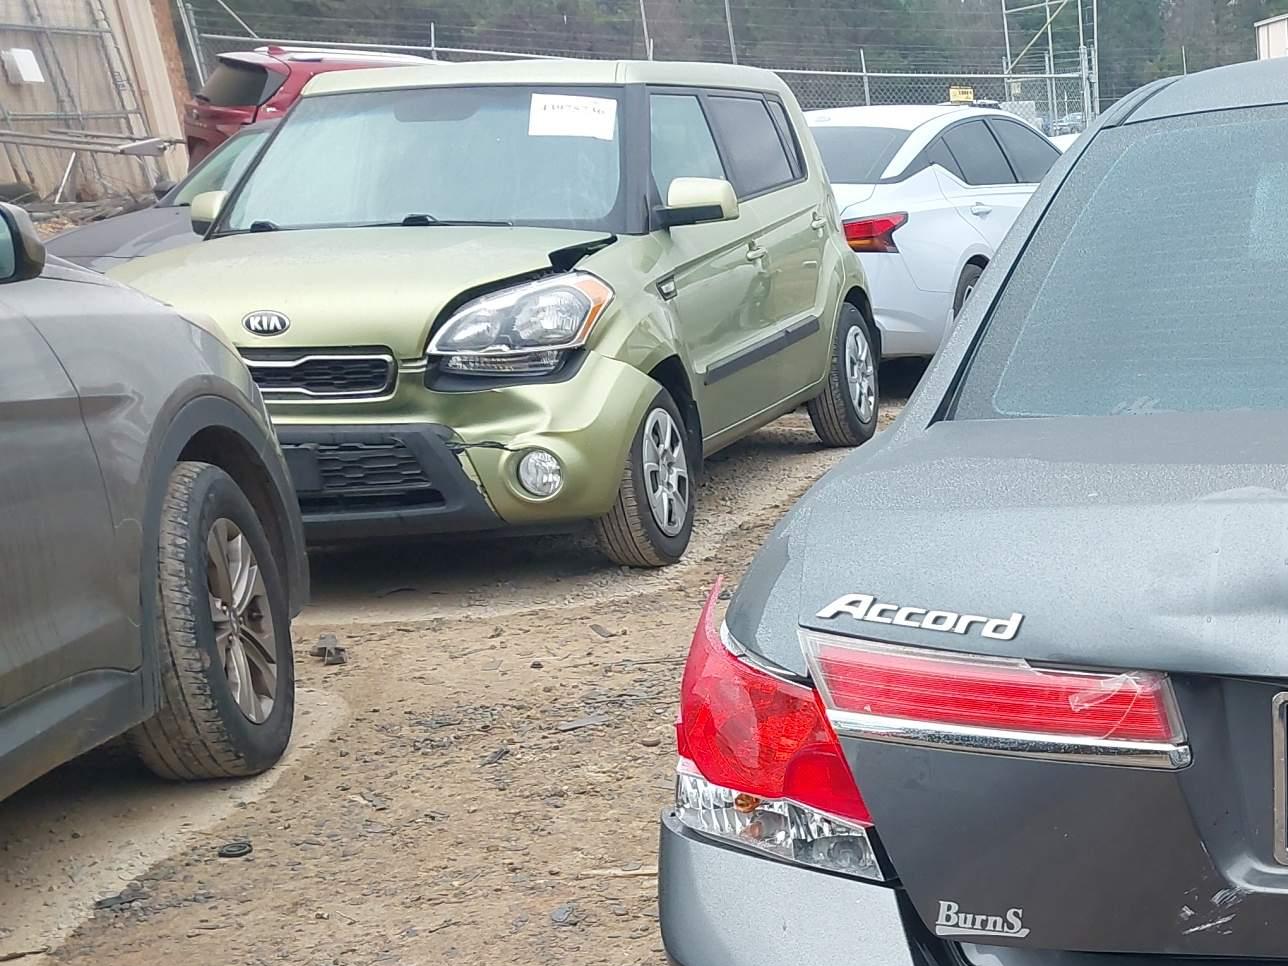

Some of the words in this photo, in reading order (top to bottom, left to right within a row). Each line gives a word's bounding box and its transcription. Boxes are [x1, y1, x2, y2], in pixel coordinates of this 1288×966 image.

[250, 316, 282, 331] KIA
[815, 593, 1025, 641] Accord
[936, 901, 1024, 934] BurnS
